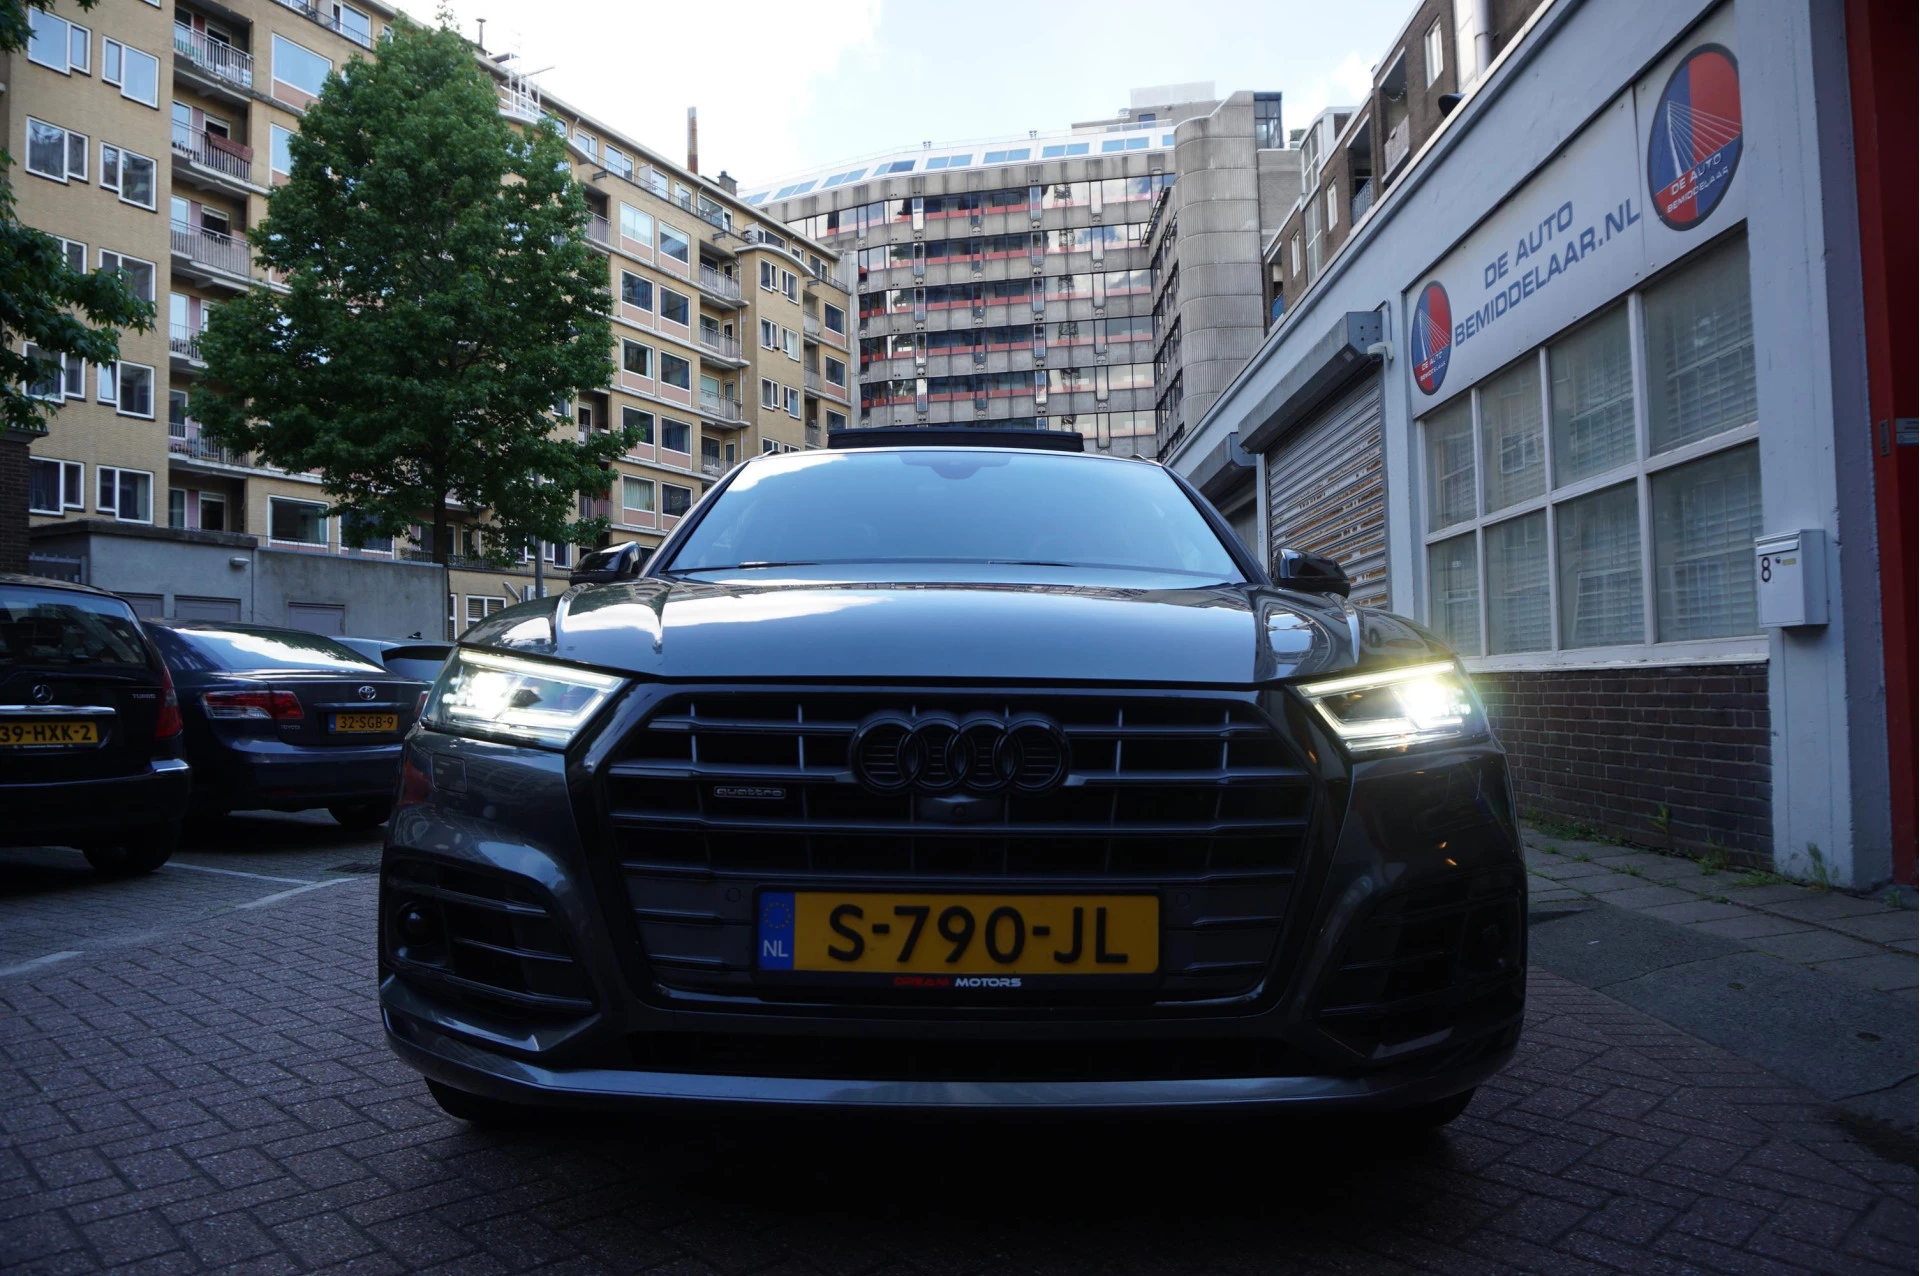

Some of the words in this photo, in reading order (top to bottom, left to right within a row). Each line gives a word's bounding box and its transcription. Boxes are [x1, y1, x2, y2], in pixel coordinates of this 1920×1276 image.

[1667, 166, 1729, 213] BEMIDDELAAR
[1671, 177, 1686, 196] DE
[1690, 152, 1722, 183] AUTO
[1484, 250, 1509, 290] DE
[1515, 200, 1574, 266] AUTO
[1455, 198, 1641, 347] BEMIDDELAAR.NL
[1761, 557, 1771, 582] 8
[0, 724, 92, 742] 39-HXK-2
[340, 716, 394, 729] 32-SGB-9
[716, 787, 783, 797] quattro
[763, 939, 788, 958] NL
[828, 903, 1128, 965] S-790-JL
[954, 977, 1022, 987] MOTORS
